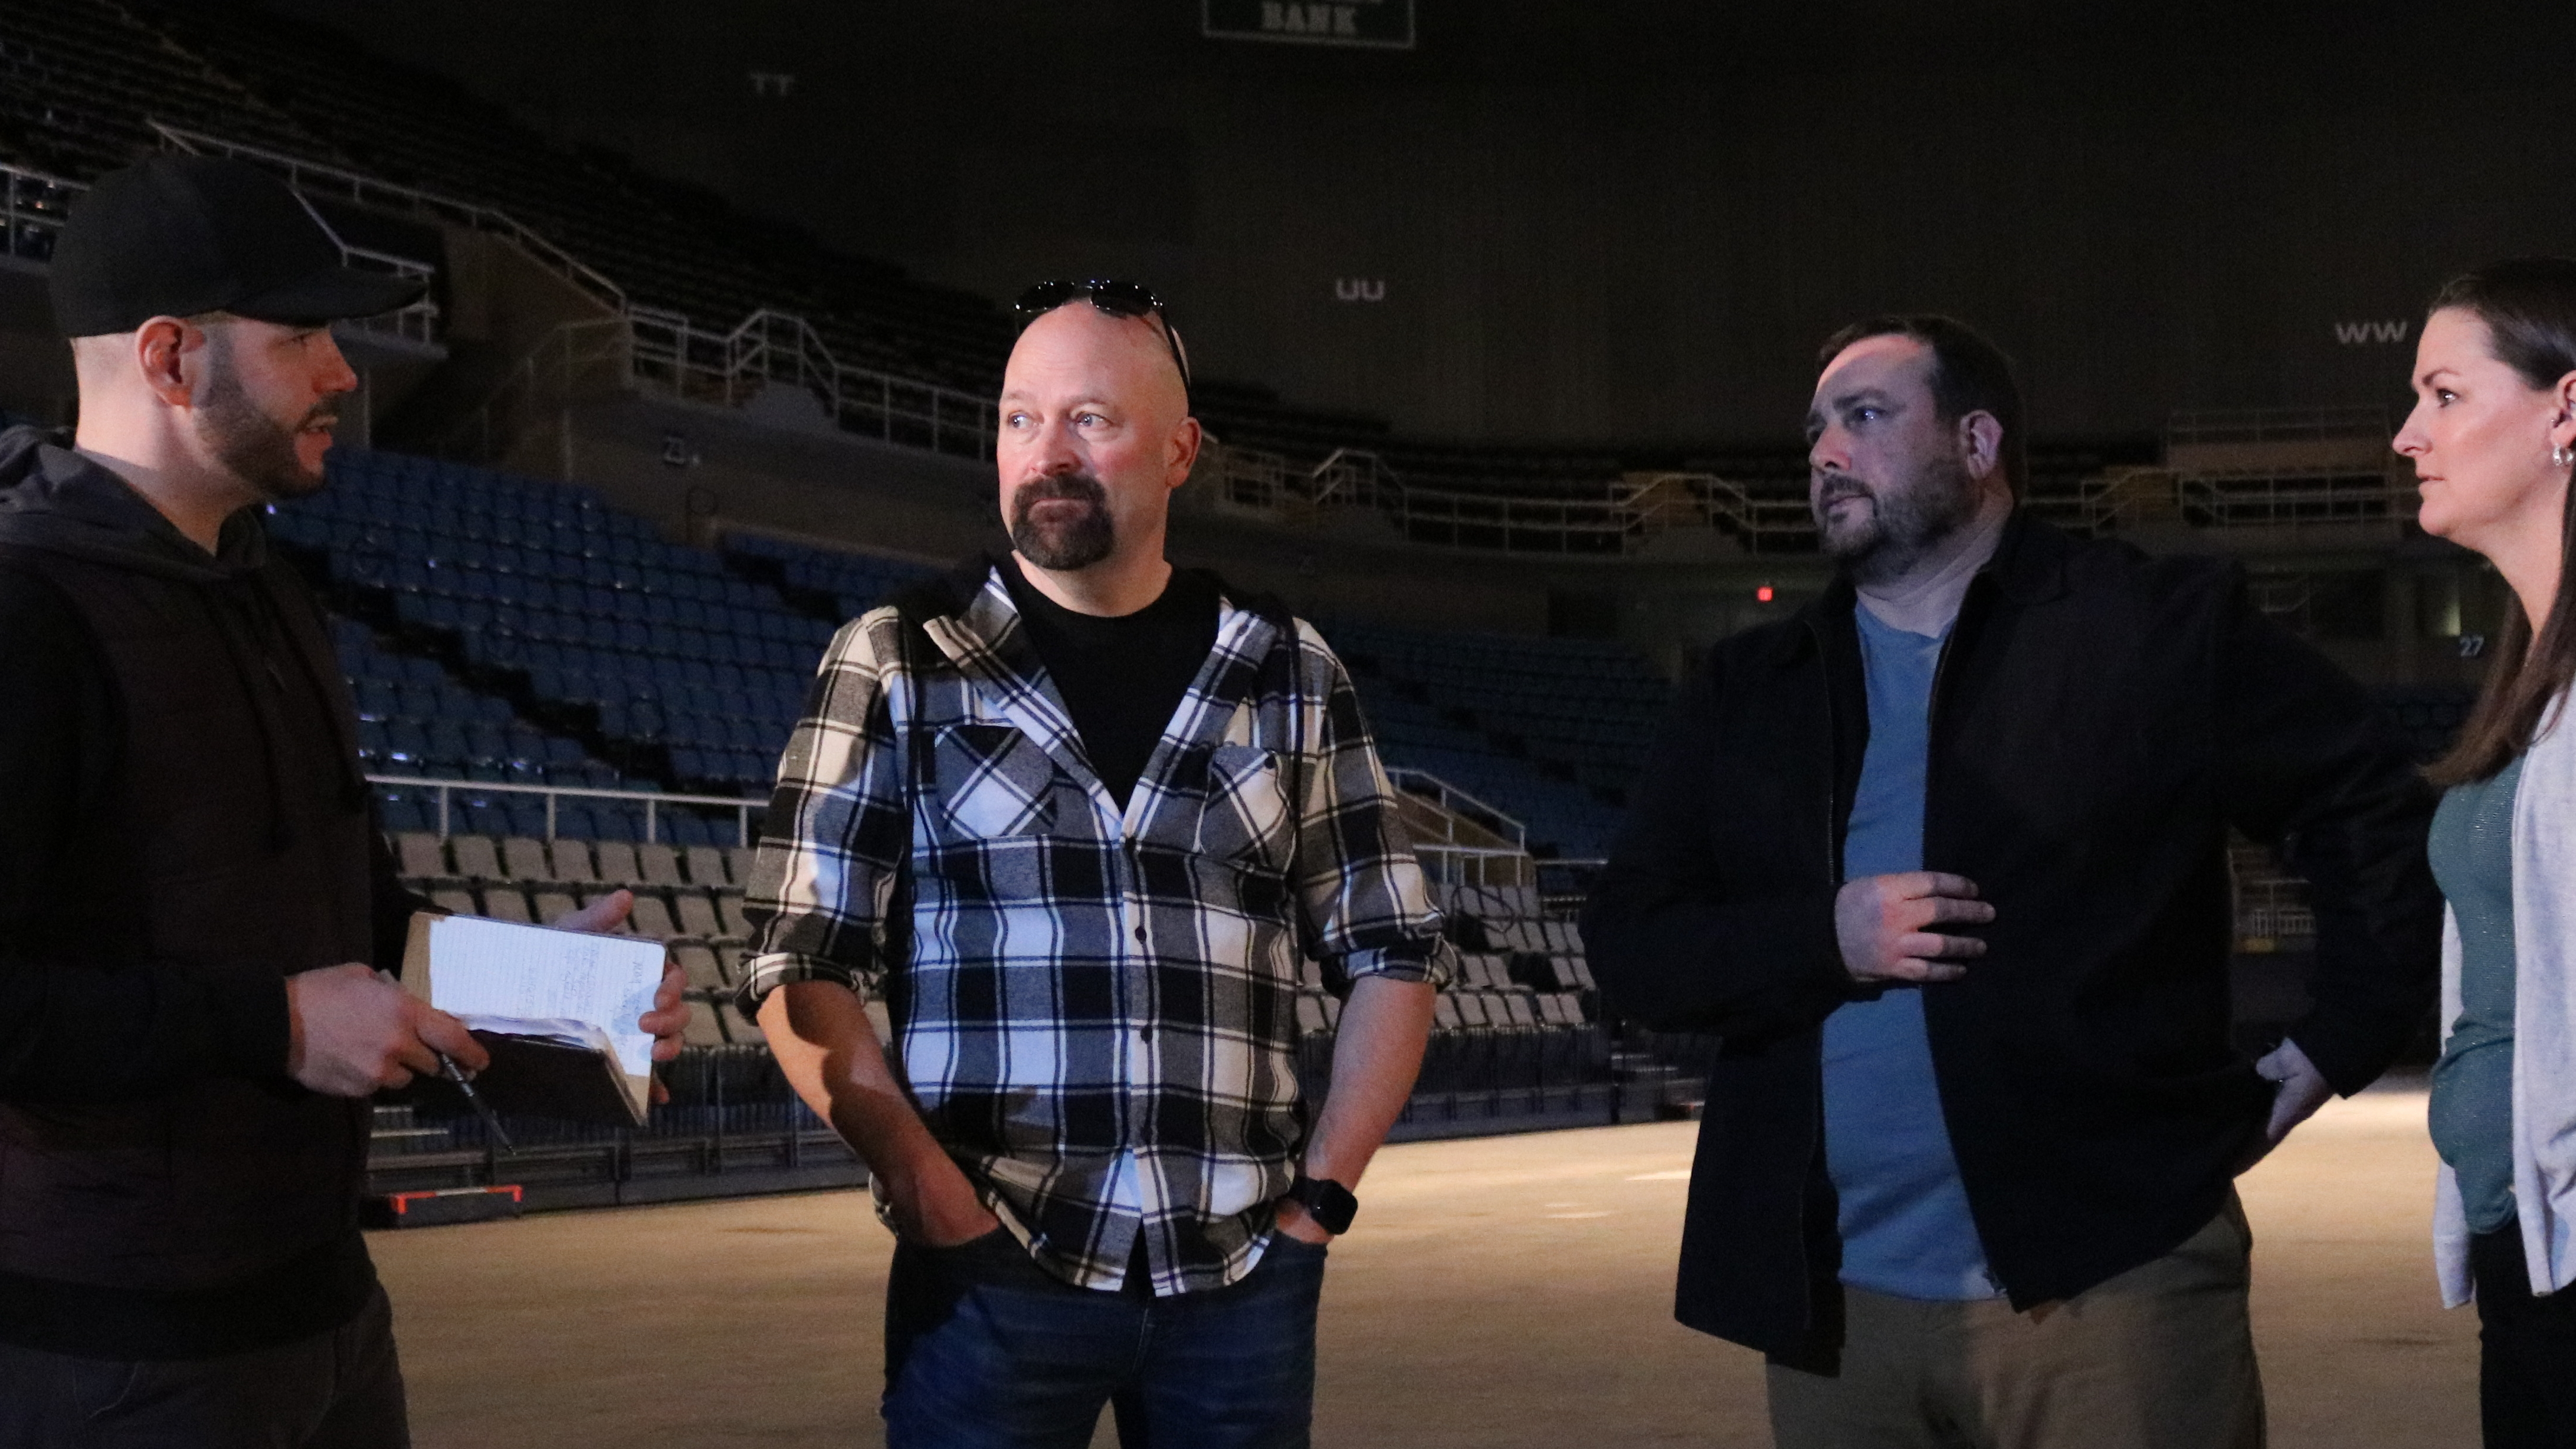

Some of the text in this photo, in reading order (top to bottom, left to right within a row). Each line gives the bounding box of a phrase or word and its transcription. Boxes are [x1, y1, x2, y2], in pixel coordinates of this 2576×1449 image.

[1261, 2, 1356, 35] BANK
[749, 71, 795, 96] TT
[1335, 276, 1385, 301] UU
[2335, 320, 2408, 343] WW
[2459, 629, 2484, 657] 27
